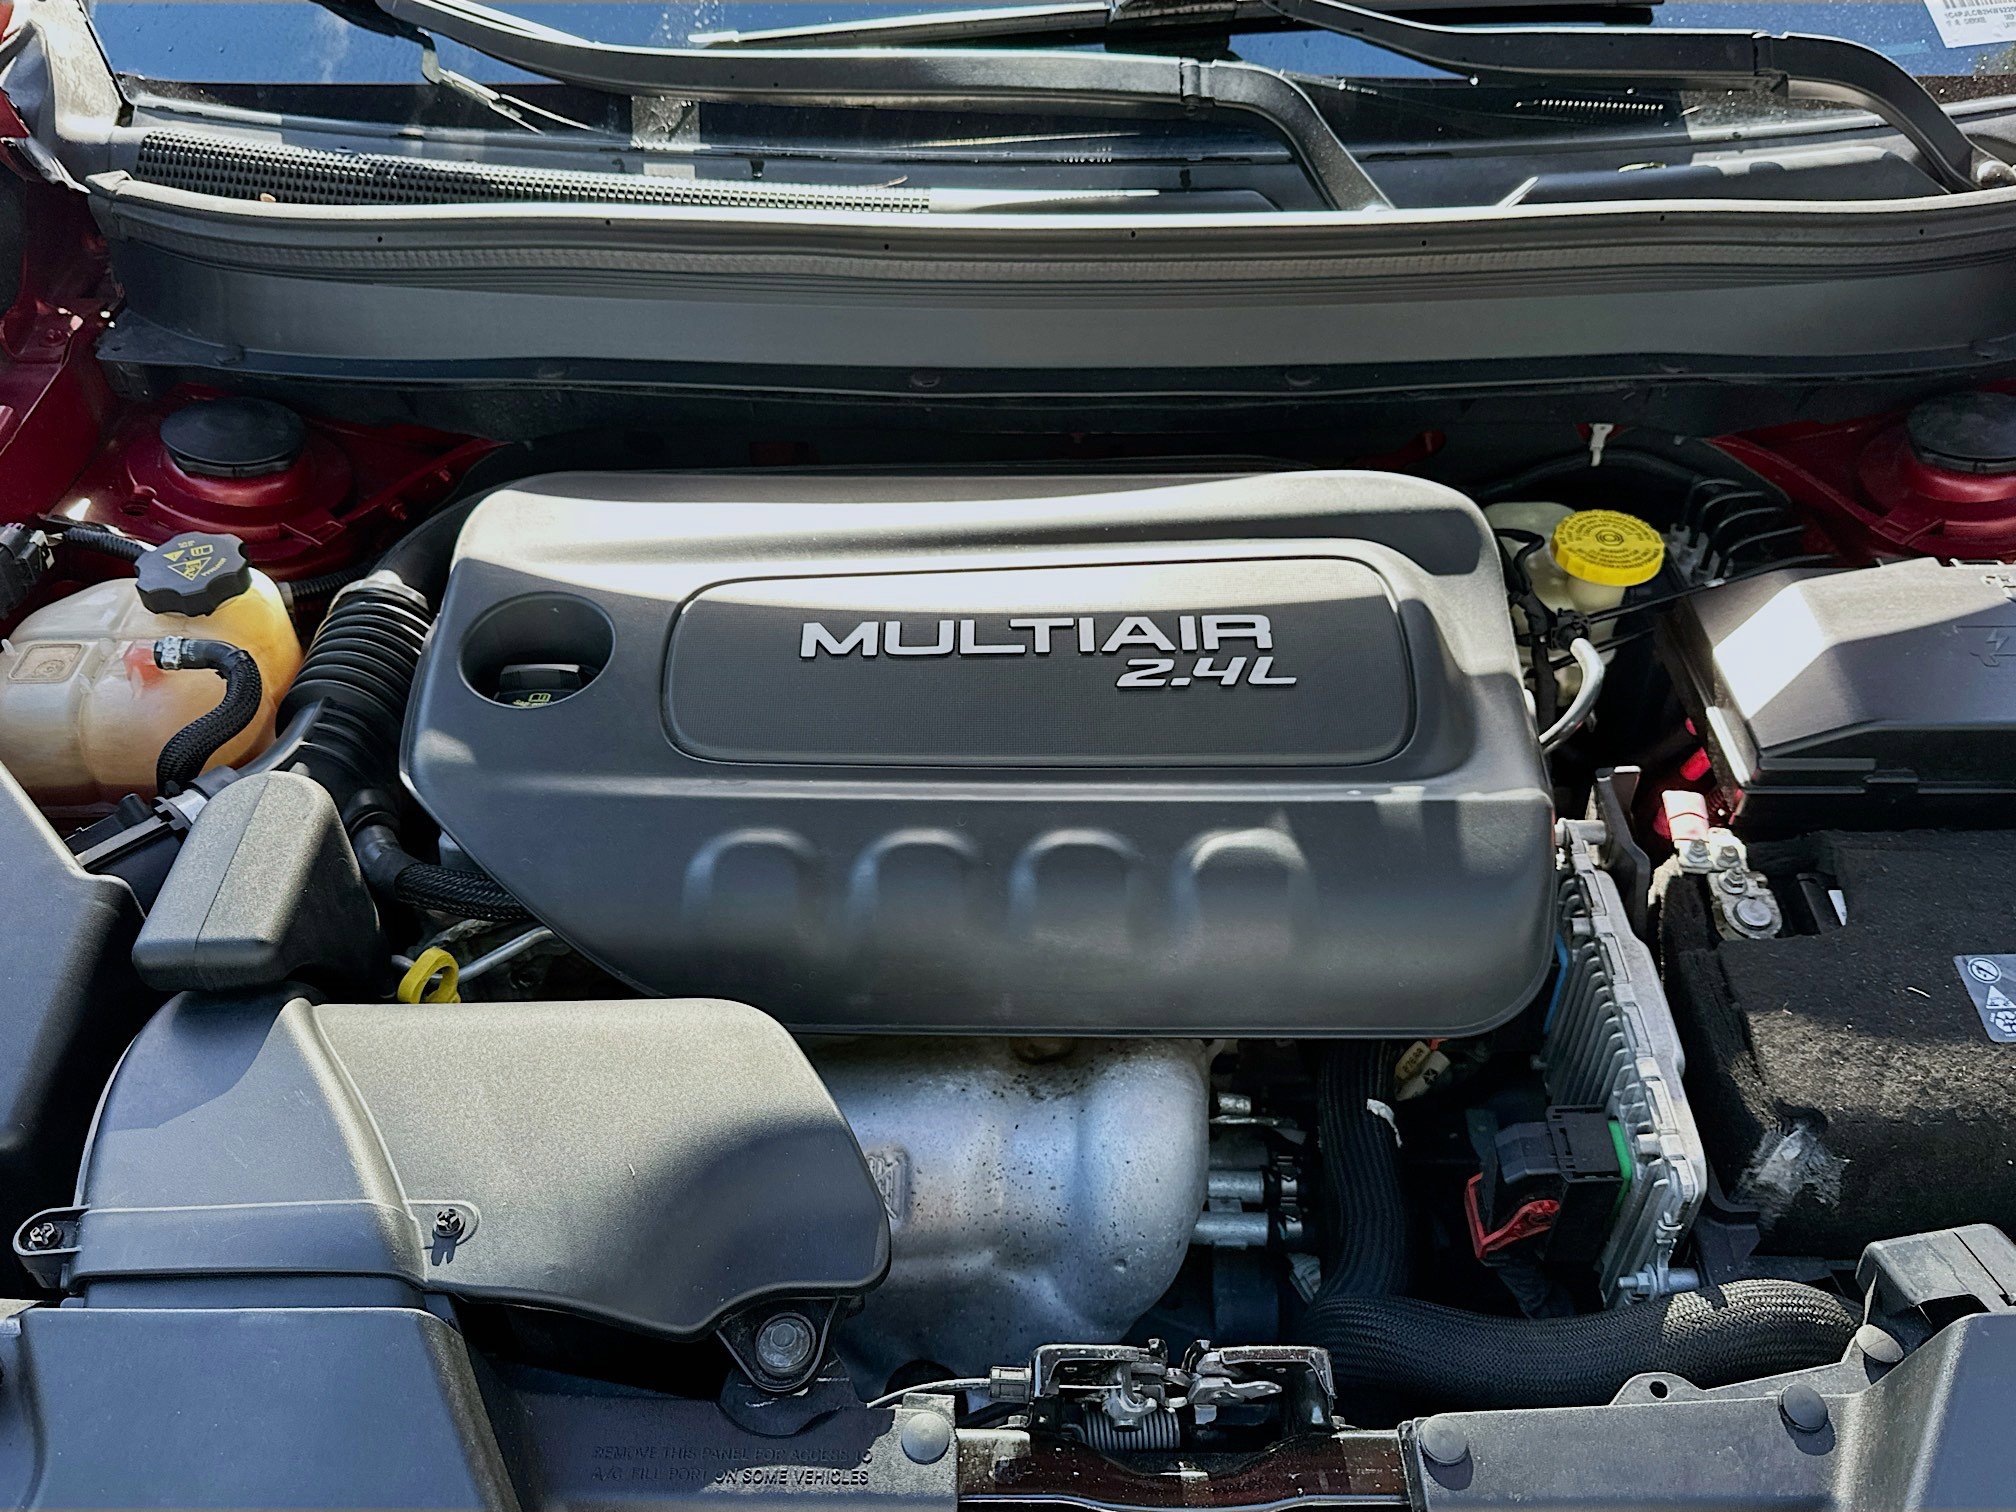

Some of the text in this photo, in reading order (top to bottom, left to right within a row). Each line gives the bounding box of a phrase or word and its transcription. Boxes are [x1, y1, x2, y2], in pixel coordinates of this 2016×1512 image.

[800, 613, 1274, 659] MULTIAIR
[1116, 656, 1298, 689] 2.4L
[593, 1446, 873, 1464] REMOVE THIS PANEL FOR ACCESS TO
[593, 1467, 869, 1486] A/C FILL PORT ON SOME VEHICLES
